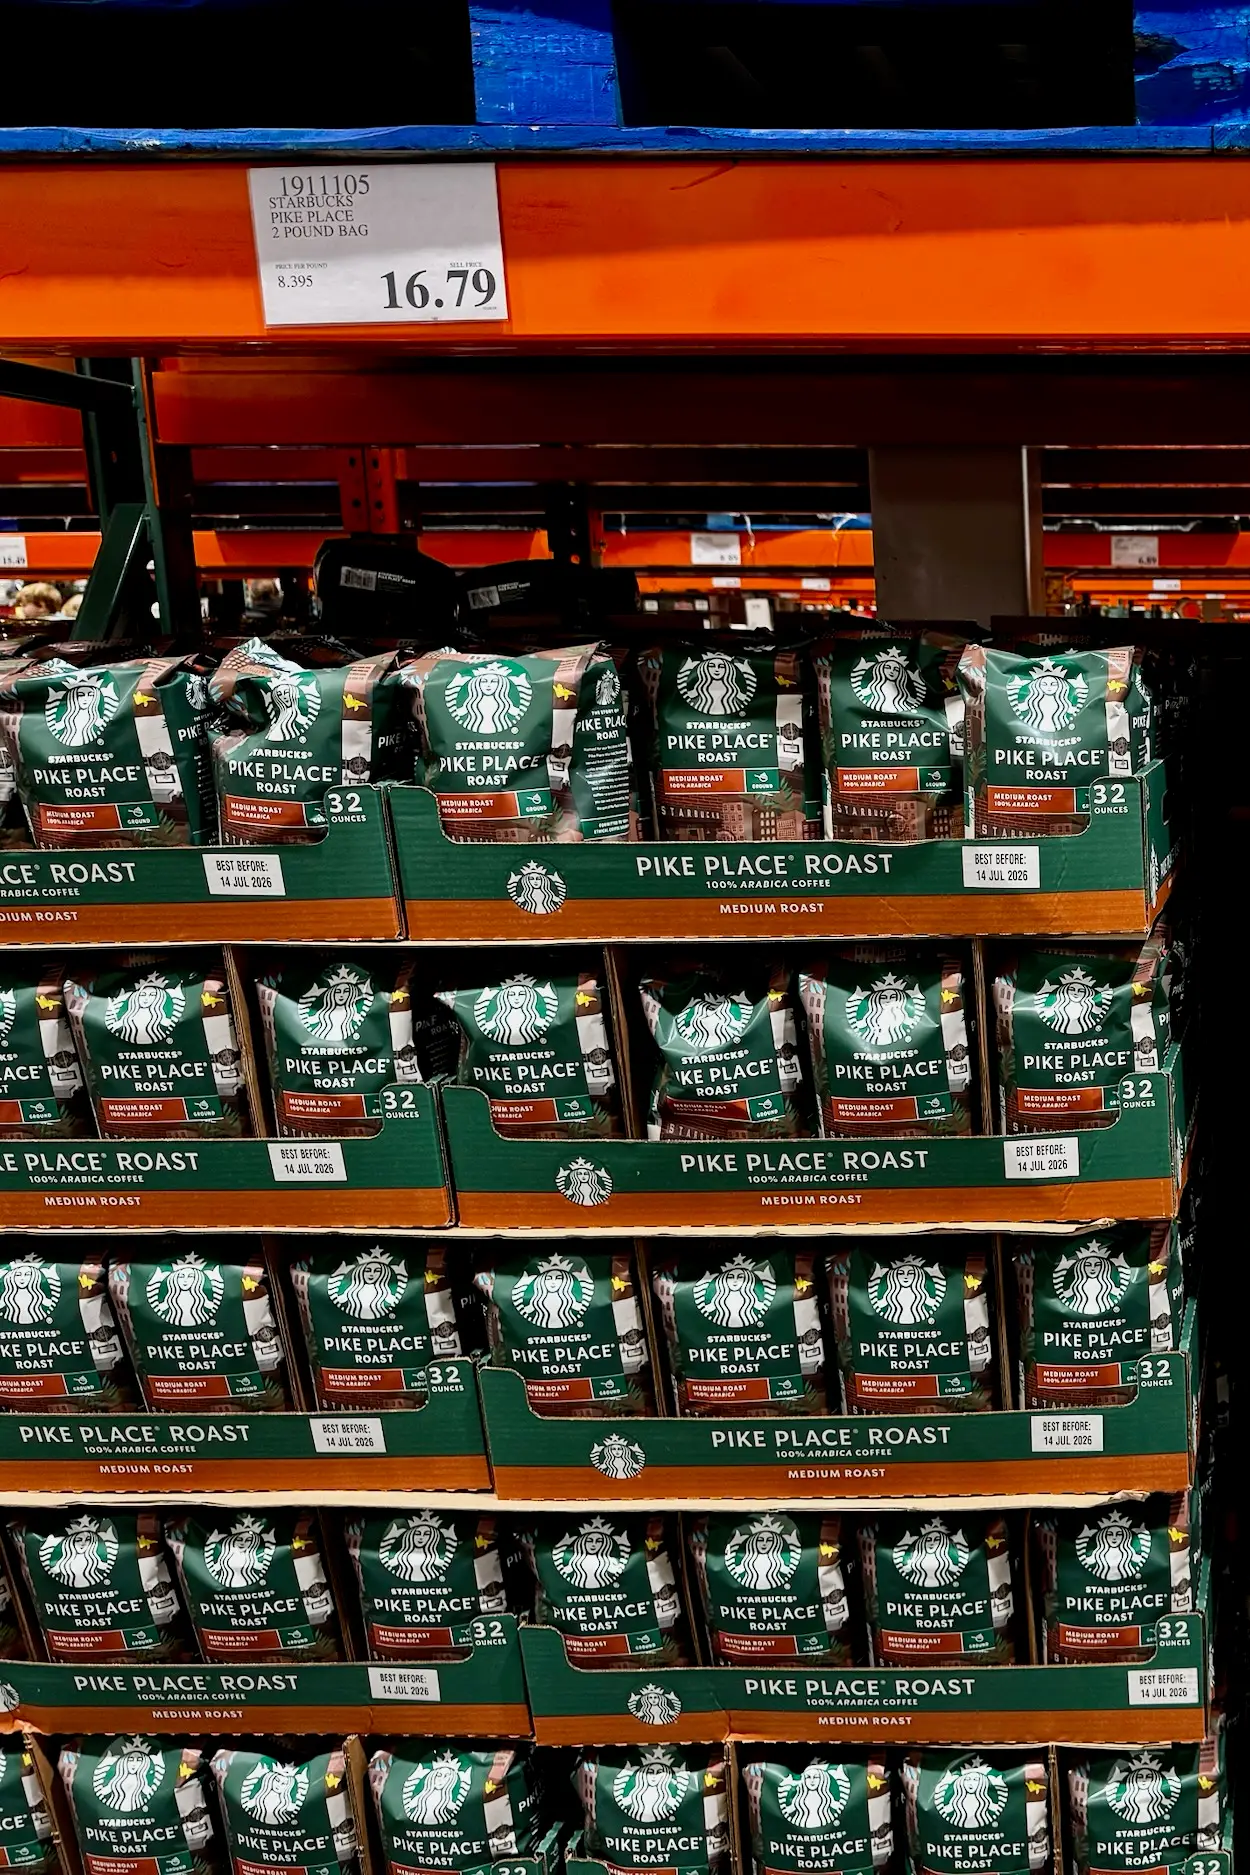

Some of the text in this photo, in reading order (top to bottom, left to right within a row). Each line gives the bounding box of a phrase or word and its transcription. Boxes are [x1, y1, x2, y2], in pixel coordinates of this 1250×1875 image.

[280, 175, 370, 196] 1911105
[269, 195, 353, 209] STARBUCKS
[271, 210, 354, 224] PIKE PLACE
[272, 225, 368, 238] 2 POUND BAG
[278, 276, 313, 288] 8.395
[381, 269, 496, 309] 16.79
[686, 721, 746, 729] STARBUCKS
[668, 734, 769, 749] PIKE PLACE
[698, 752, 738, 762] ROAST
[1093, 784, 1126, 804] 32
[329, 793, 362, 813] 32
[1094, 806, 1128, 814] OUNCES
[331, 814, 366, 823] OUNCES
[636, 854, 892, 876] PIKE PLACE ROAST
[975, 853, 1027, 865] BEST BEFORE:
[51, 862, 136, 884] ROAST
[976, 870, 1028, 881] 14 JUL 2026
[706, 879, 830, 889] 100% ARABICA COFFEE
[42, 888, 80, 897] COFFEE
[720, 903, 824, 914] MEDIUM ROAST
[36, 912, 77, 921] ROAST
[854, 1051, 913, 1060] STARBUCKS
[836, 1063, 938, 1080] PIKE PLACE
[866, 1082, 907, 1092] ROAST
[1016, 1145, 1066, 1156] BEST BEFORE:
[681, 1151, 928, 1173] PIKE PLACE ROAST
[1018, 1160, 1068, 1172] 14 JUL 2026
[1063, 1320, 1122, 1329] STARBUCKS
[1044, 1330, 1143, 1347] PIKE PLACE
[1074, 1349, 1113, 1359] ROAST
[19, 1425, 249, 1443] PIKE PLACE ROAST
[100, 1464, 193, 1474] MEDIUM ROAST
[1159, 1622, 1188, 1638] 32
[745, 1679, 975, 1695] PIKE PLACE ROAST
[99, 1819, 150, 1827] STARBUCKS
[86, 1826, 175, 1842] PIKE PLACE
[112, 1844, 147, 1854] ROAST
